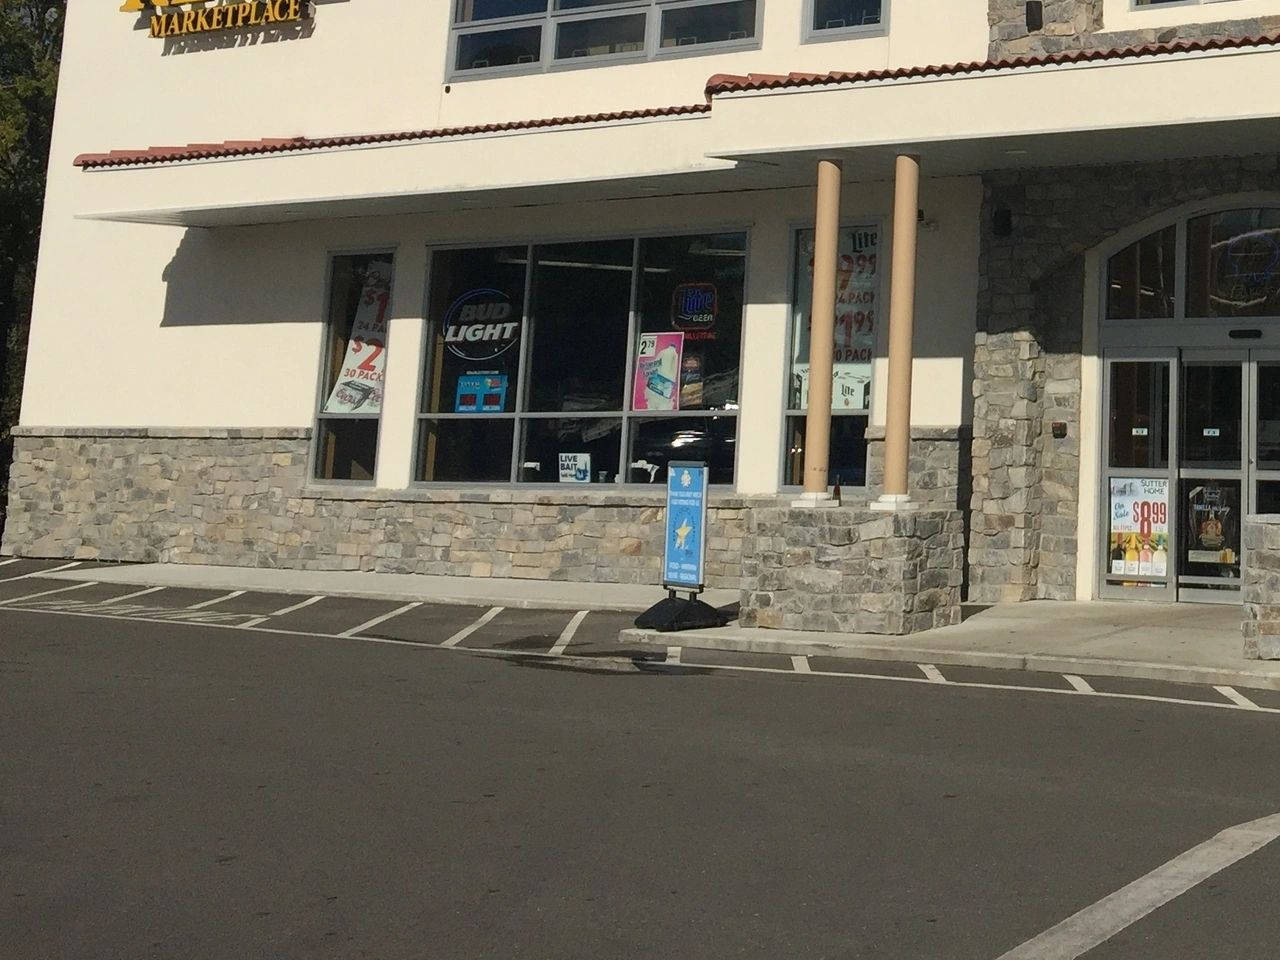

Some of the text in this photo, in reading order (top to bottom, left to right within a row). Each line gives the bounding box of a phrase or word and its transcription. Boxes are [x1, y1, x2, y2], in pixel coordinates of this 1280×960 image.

[852, 231, 877, 253] Lite
[460, 302, 512, 321] BUD
[445, 322, 518, 342] LIGHT
[344, 368, 384, 382] 30 PACK
[560, 463, 578, 471] BAIT
